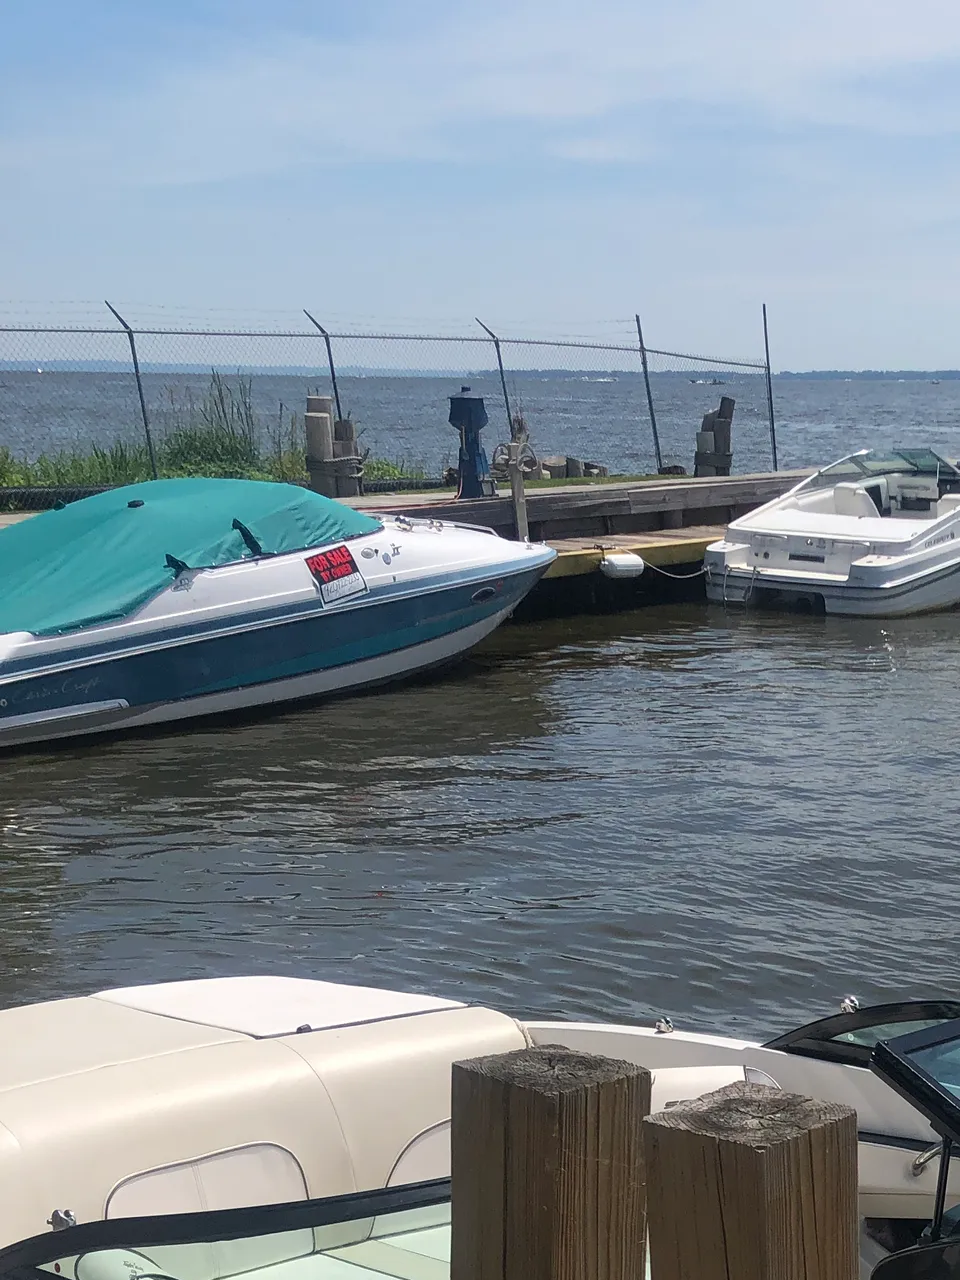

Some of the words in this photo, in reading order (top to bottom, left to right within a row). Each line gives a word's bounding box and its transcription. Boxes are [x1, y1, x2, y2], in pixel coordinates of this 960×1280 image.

[307, 555, 331, 574] FOR
[326, 547, 353, 566] SALE
[320, 570, 331, 582] BY
